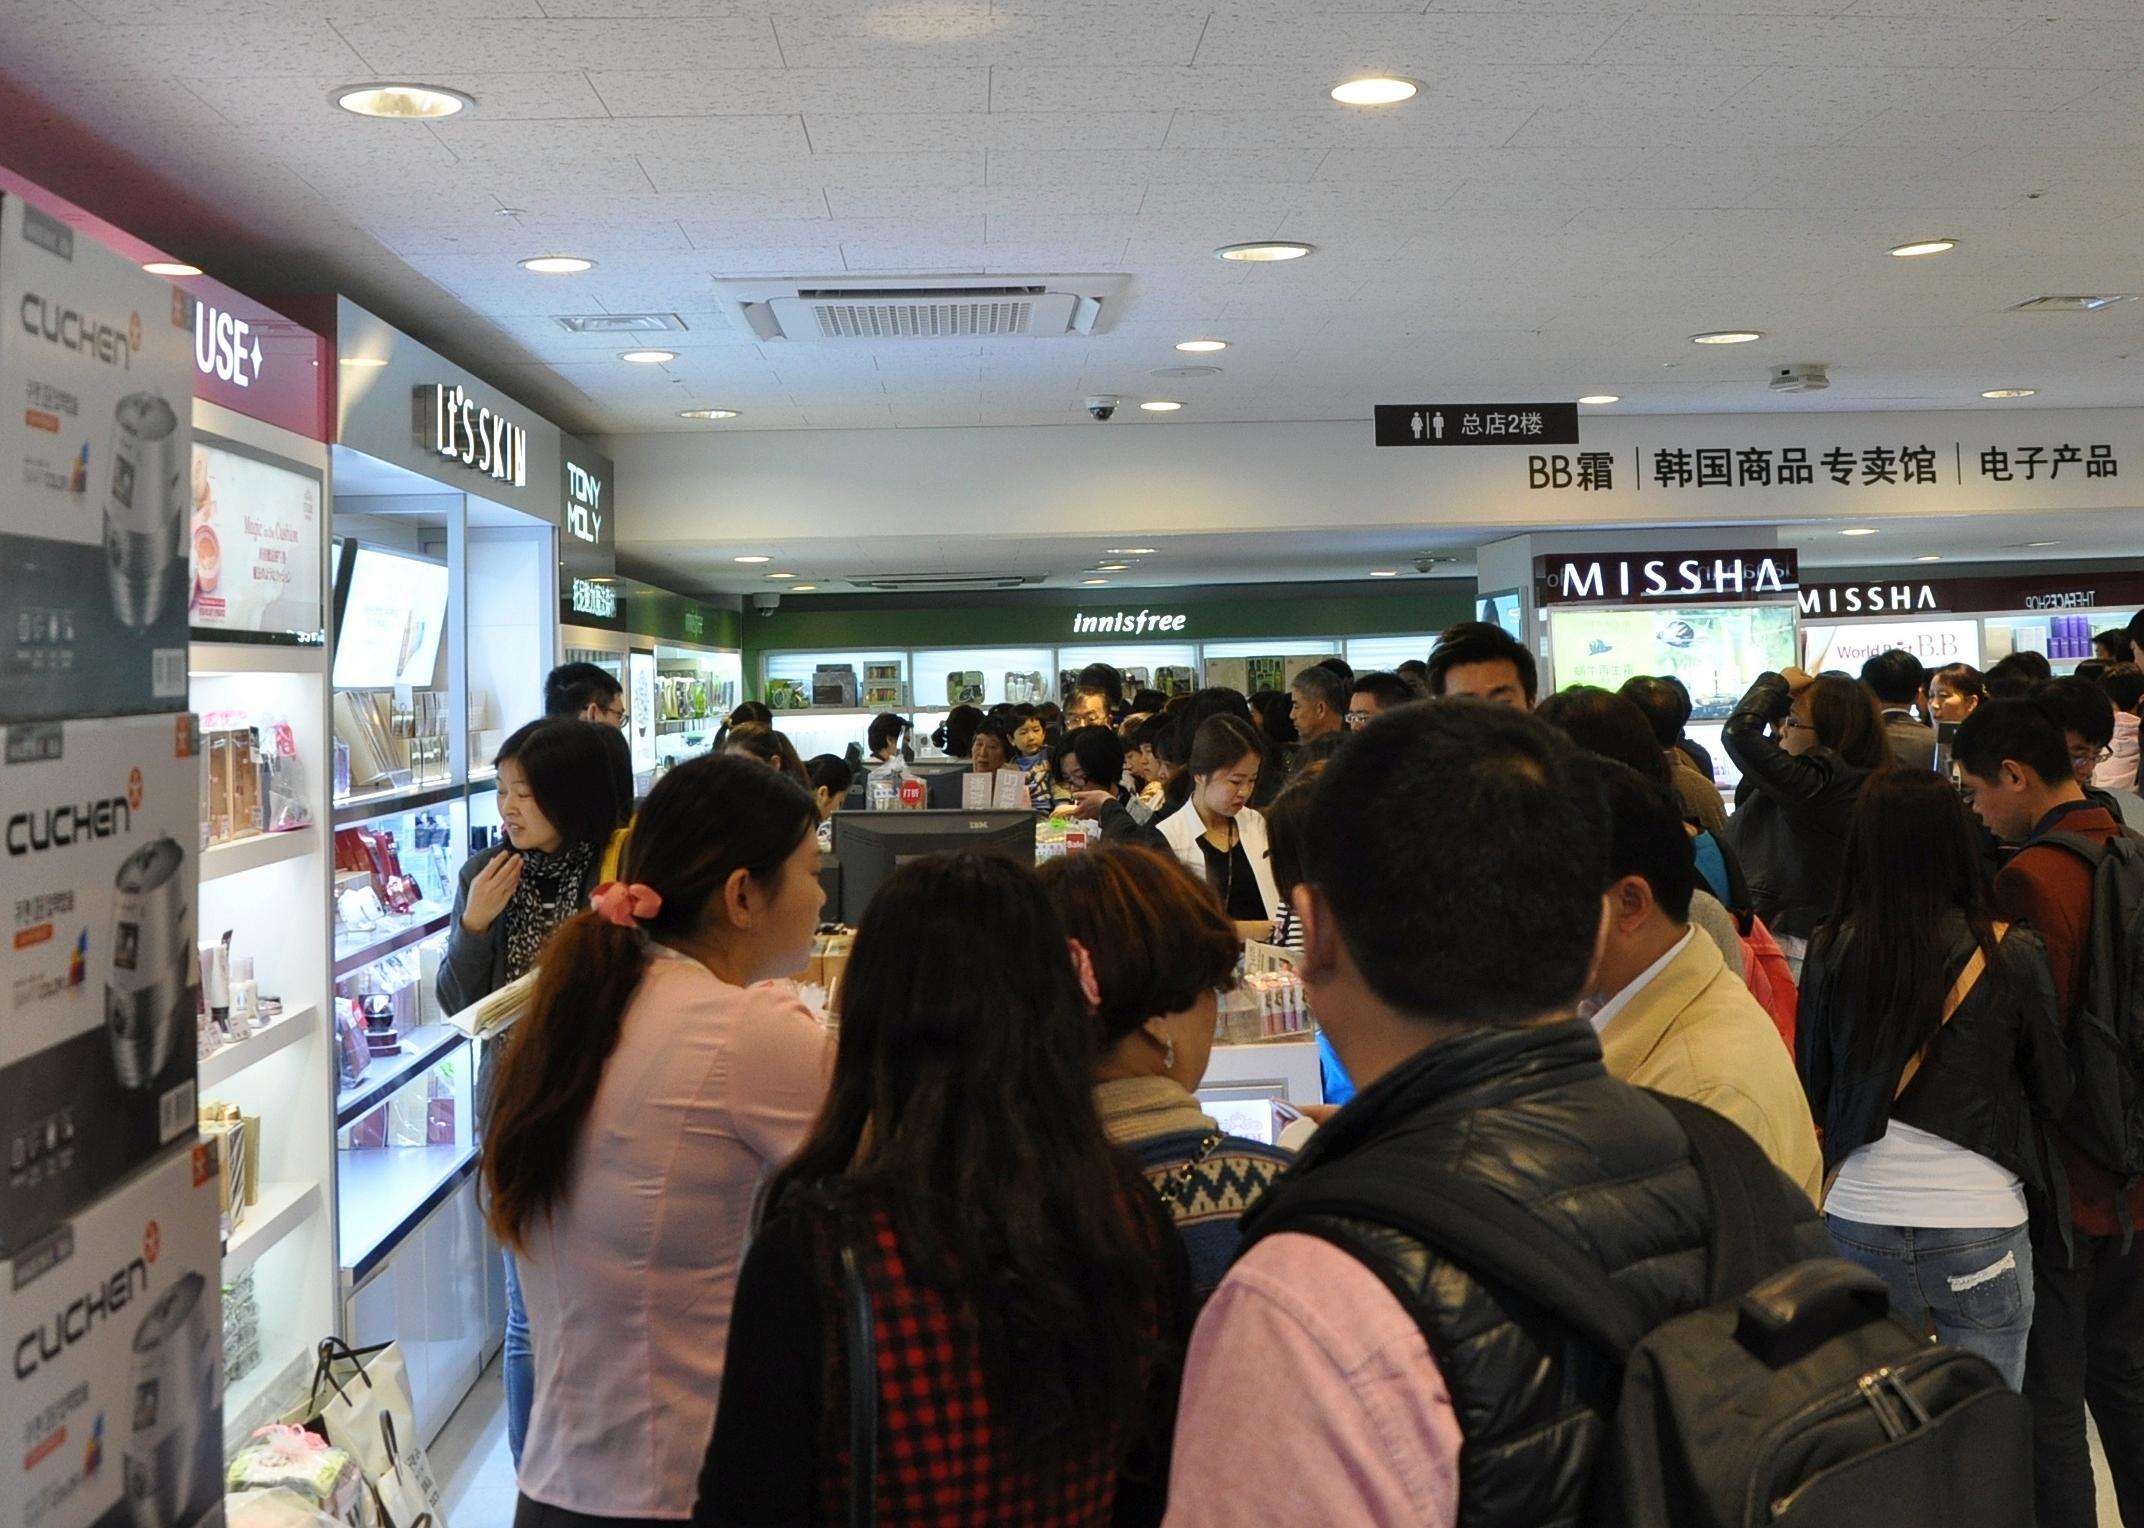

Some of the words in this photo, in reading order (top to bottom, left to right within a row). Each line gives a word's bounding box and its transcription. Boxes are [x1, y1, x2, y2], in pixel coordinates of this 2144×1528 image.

[21, 293, 130, 370] CUCHEN
[1461, 411, 1544, 436] 总店2楼
[479, 407, 526, 487] SKIN
[1528, 451, 1614, 491] BB霜
[1653, 444, 1937, 489] 韩国商品专卖馆
[1979, 443, 2118, 481] 电子产品
[567, 462, 602, 510] TONY
[567, 501, 602, 544] MOLY
[1562, 558, 1783, 597] MISSHA
[1797, 585, 1937, 614] MISSHA
[1073, 609, 1187, 635] innisfree
[1837, 644, 1879, 658] World
[6, 796, 131, 856] CUCHEN
[14, 1256, 148, 1381] CUCHEN
